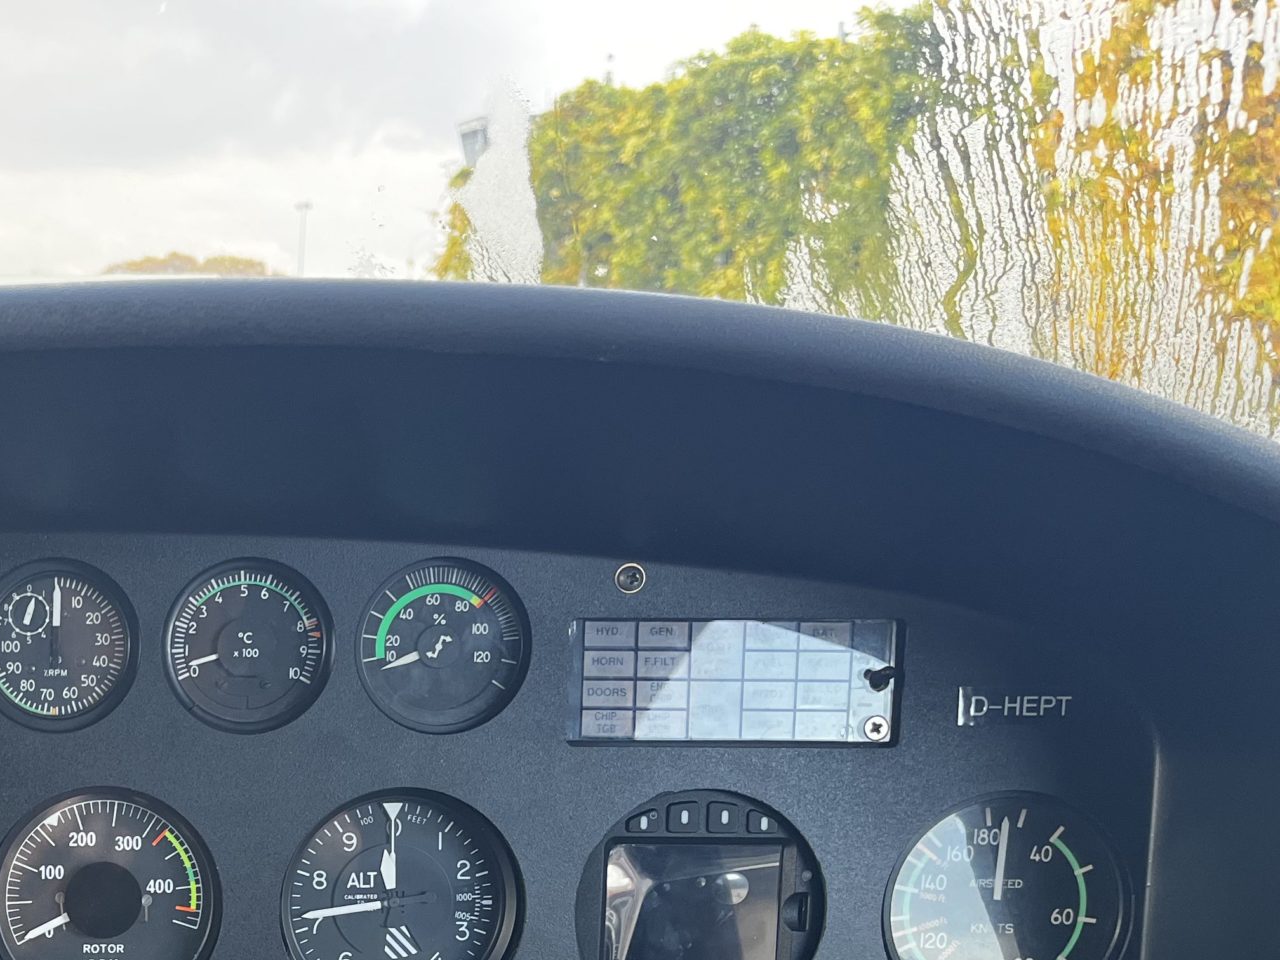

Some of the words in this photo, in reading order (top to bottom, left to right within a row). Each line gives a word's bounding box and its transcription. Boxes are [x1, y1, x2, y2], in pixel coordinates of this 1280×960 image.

[72, 596, 82, 608] 10
[426, 595, 440, 605] 60
[455, 601, 469, 611] 80
[86, 612, 101, 624] 20
[400, 609, 413, 619] 40
[472, 623, 488, 634] 100
[650, 627, 673, 636] GEN
[95, 634, 110, 645] 30
[386, 635, 400, 646] 20
[1, 641, 20, 653] 100
[92, 656, 108, 667] 40
[386, 651, 396, 661] 10
[474, 651, 490, 662] 120
[592, 657, 623, 666] HORN
[6, 662, 21, 674] 90
[289, 668, 299, 679] 10
[20, 680, 35, 691] 80
[81, 675, 96, 686] 50
[40, 689, 54, 700] 70
[63, 687, 78, 699] 60
[588, 688, 627, 696] DOORS
[971, 696, 1072, 716] D-HEPT
[69, 832, 96, 847] 200
[343, 833, 357, 851] 9
[973, 829, 1000, 845] 180
[115, 836, 142, 851] 300
[947, 846, 973, 862] 160
[1030, 846, 1052, 862] 40
[39, 865, 64, 880] 100
[456, 860, 470, 879] 2
[312, 871, 327, 889] 8
[347, 872, 377, 888] ALT
[921, 874, 947, 890] 140
[146, 880, 173, 893] 400
[1050, 909, 1073, 925] 60
[456, 922, 470, 941] 3
[920, 933, 947, 948] 120
[83, 944, 124, 953] ROTOR
